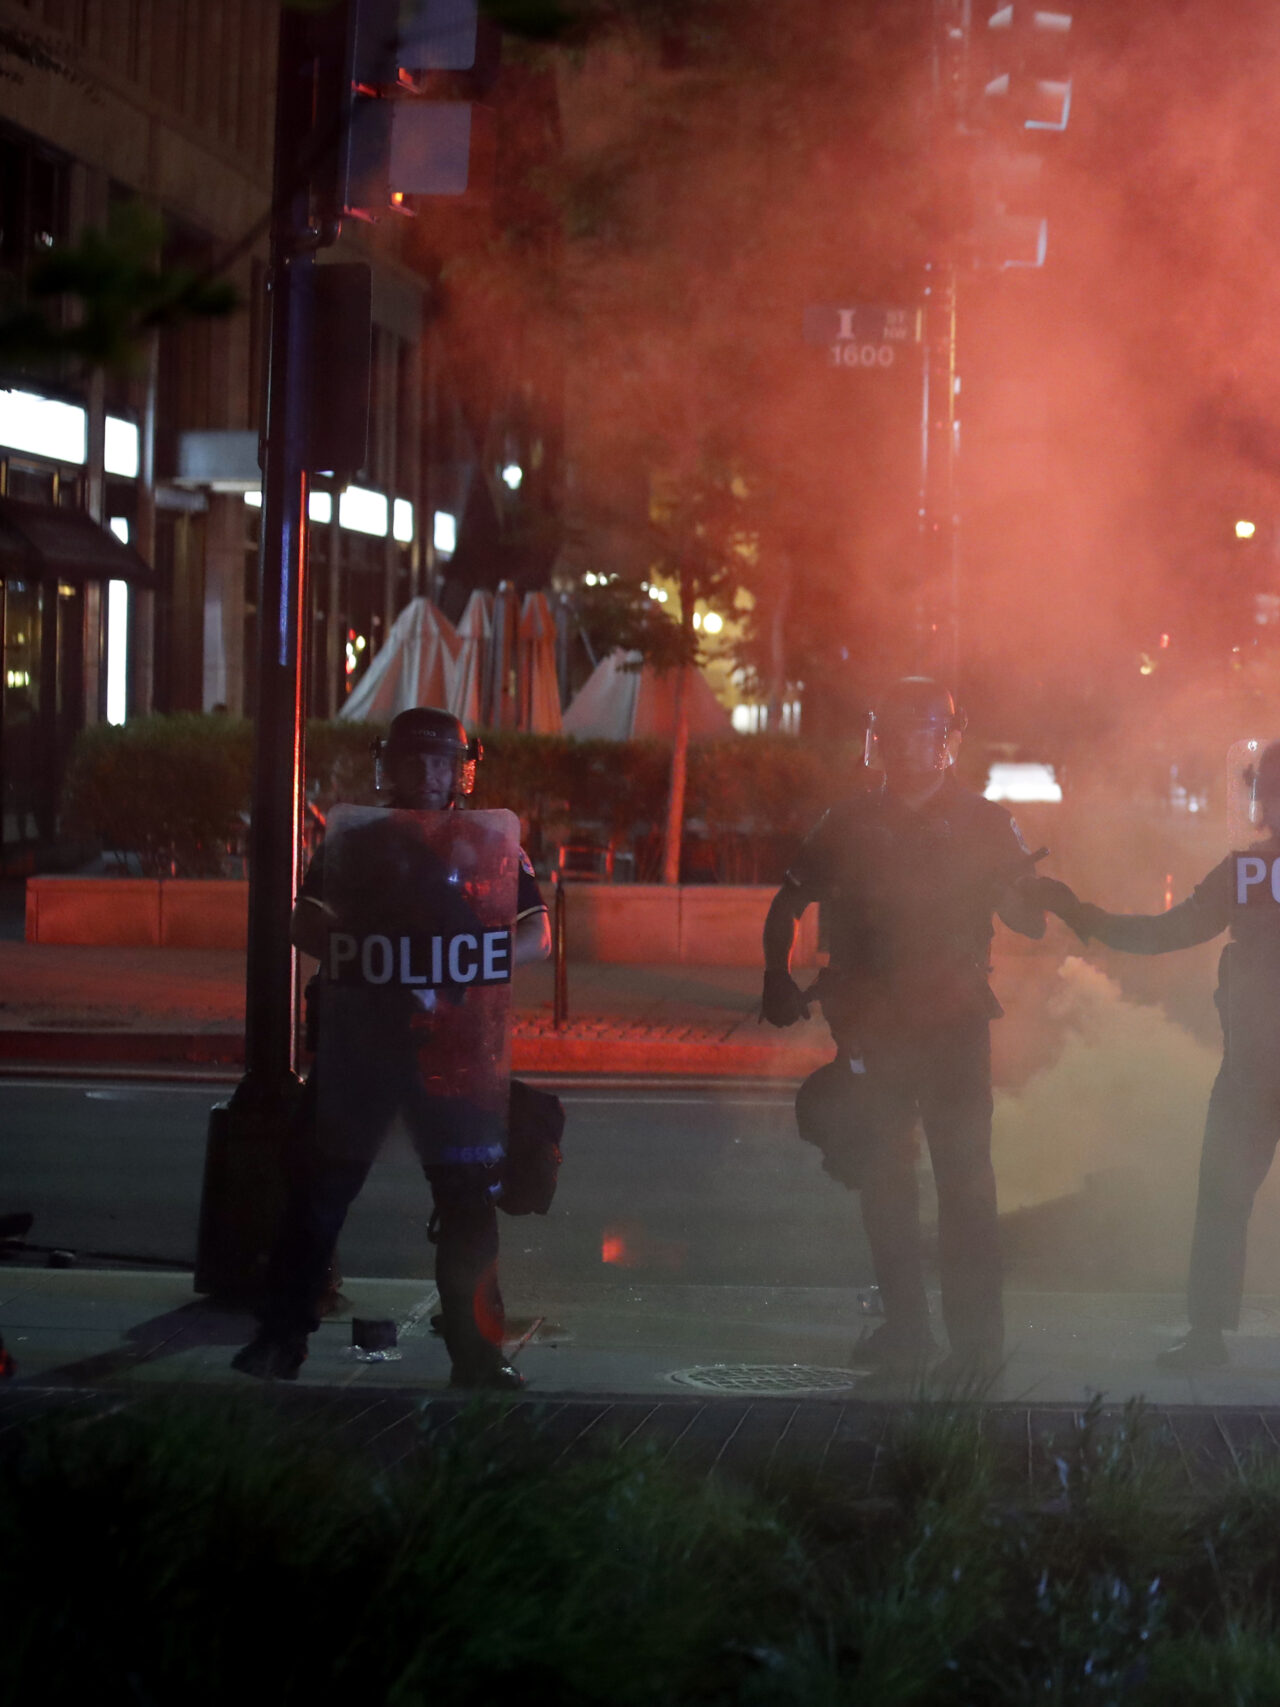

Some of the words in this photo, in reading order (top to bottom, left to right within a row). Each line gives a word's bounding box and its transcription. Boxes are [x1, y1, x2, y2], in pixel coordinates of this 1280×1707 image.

[837, 309, 855, 338] I
[830, 345, 894, 366] 1600
[330, 931, 508, 984] POLICE
